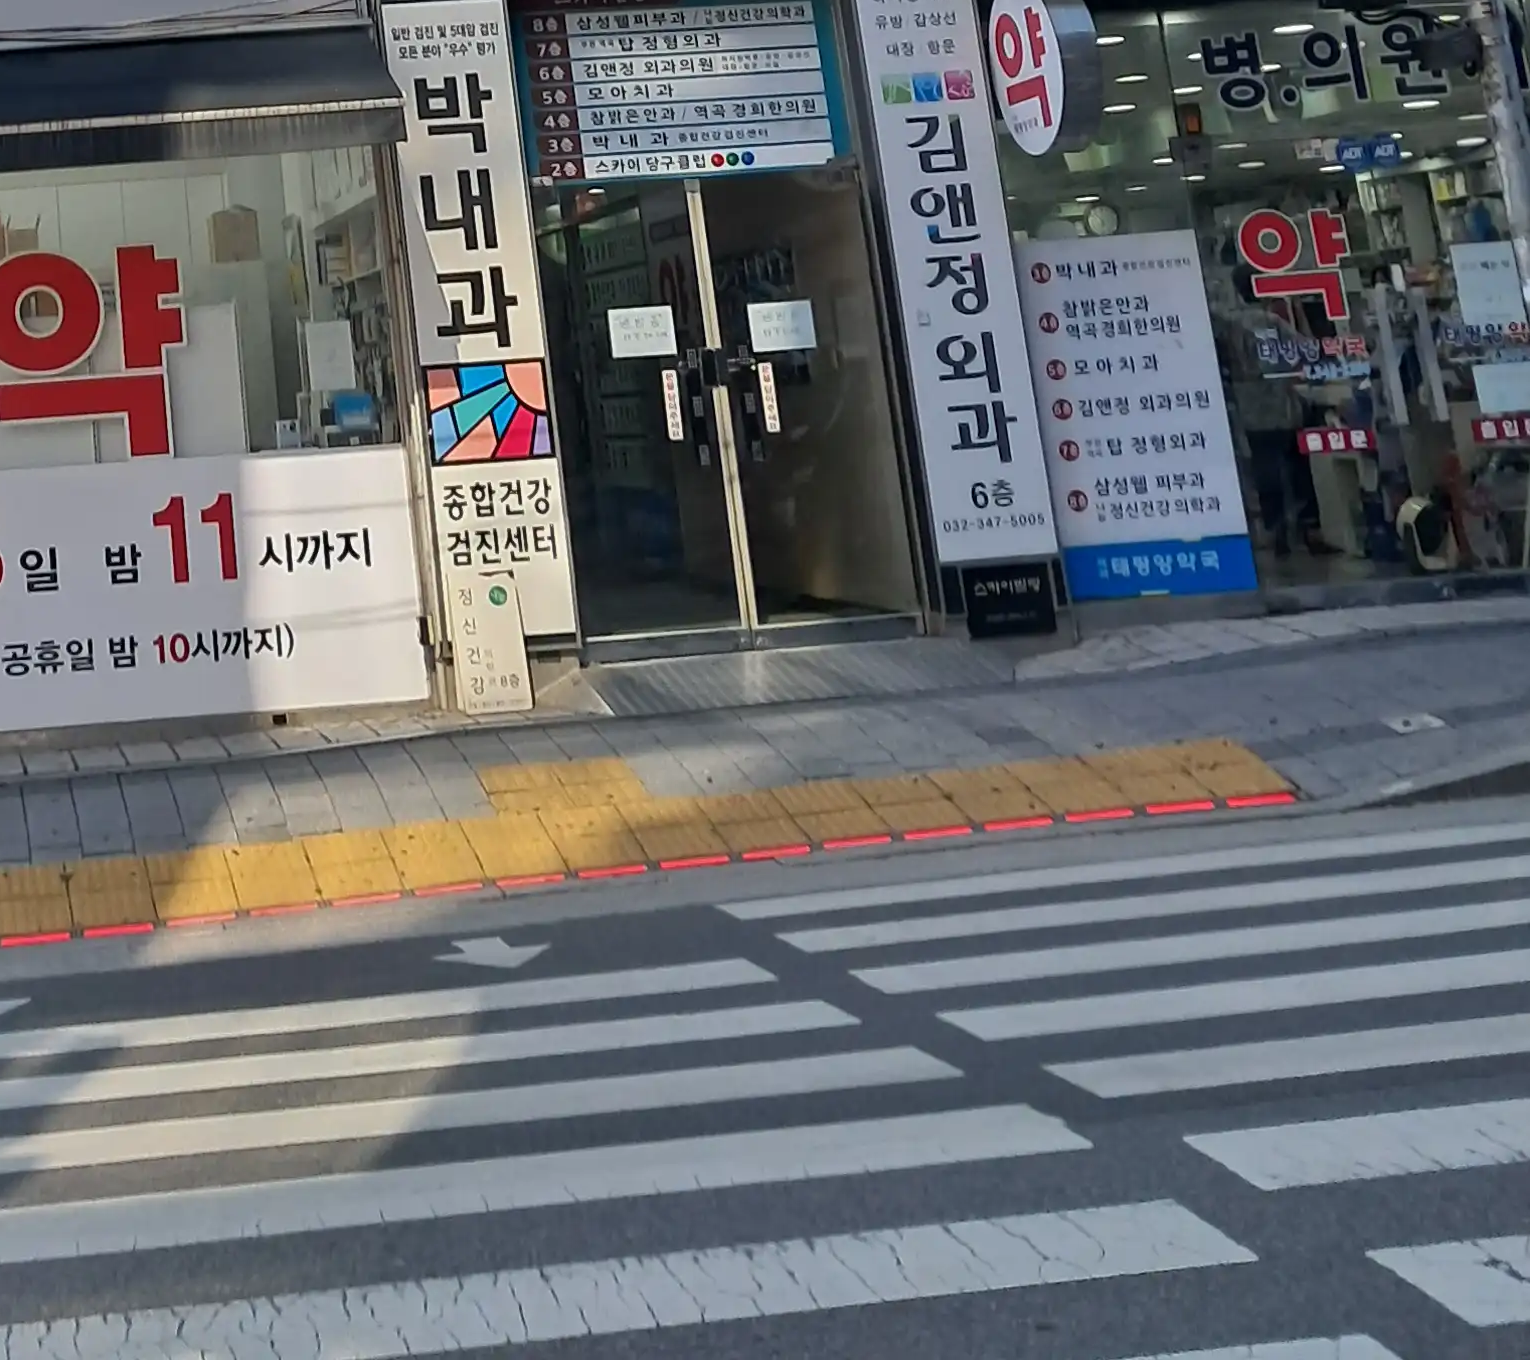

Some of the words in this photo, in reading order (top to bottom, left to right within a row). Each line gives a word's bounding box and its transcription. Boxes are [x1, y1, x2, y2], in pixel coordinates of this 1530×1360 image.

[995, 5, 1054, 129] 약
[415, 72, 519, 350] 박내과
[1239, 208, 1351, 321] 약
[442, 476, 553, 522] 종합건강
[970, 479, 1015, 510] 6층
[942, 512, 1046, 533] 032-347-5005
[447, 523, 559, 568] 검진센터
[1, 637, 96, 678] 공휴일
[107, 633, 139, 669] 밤
